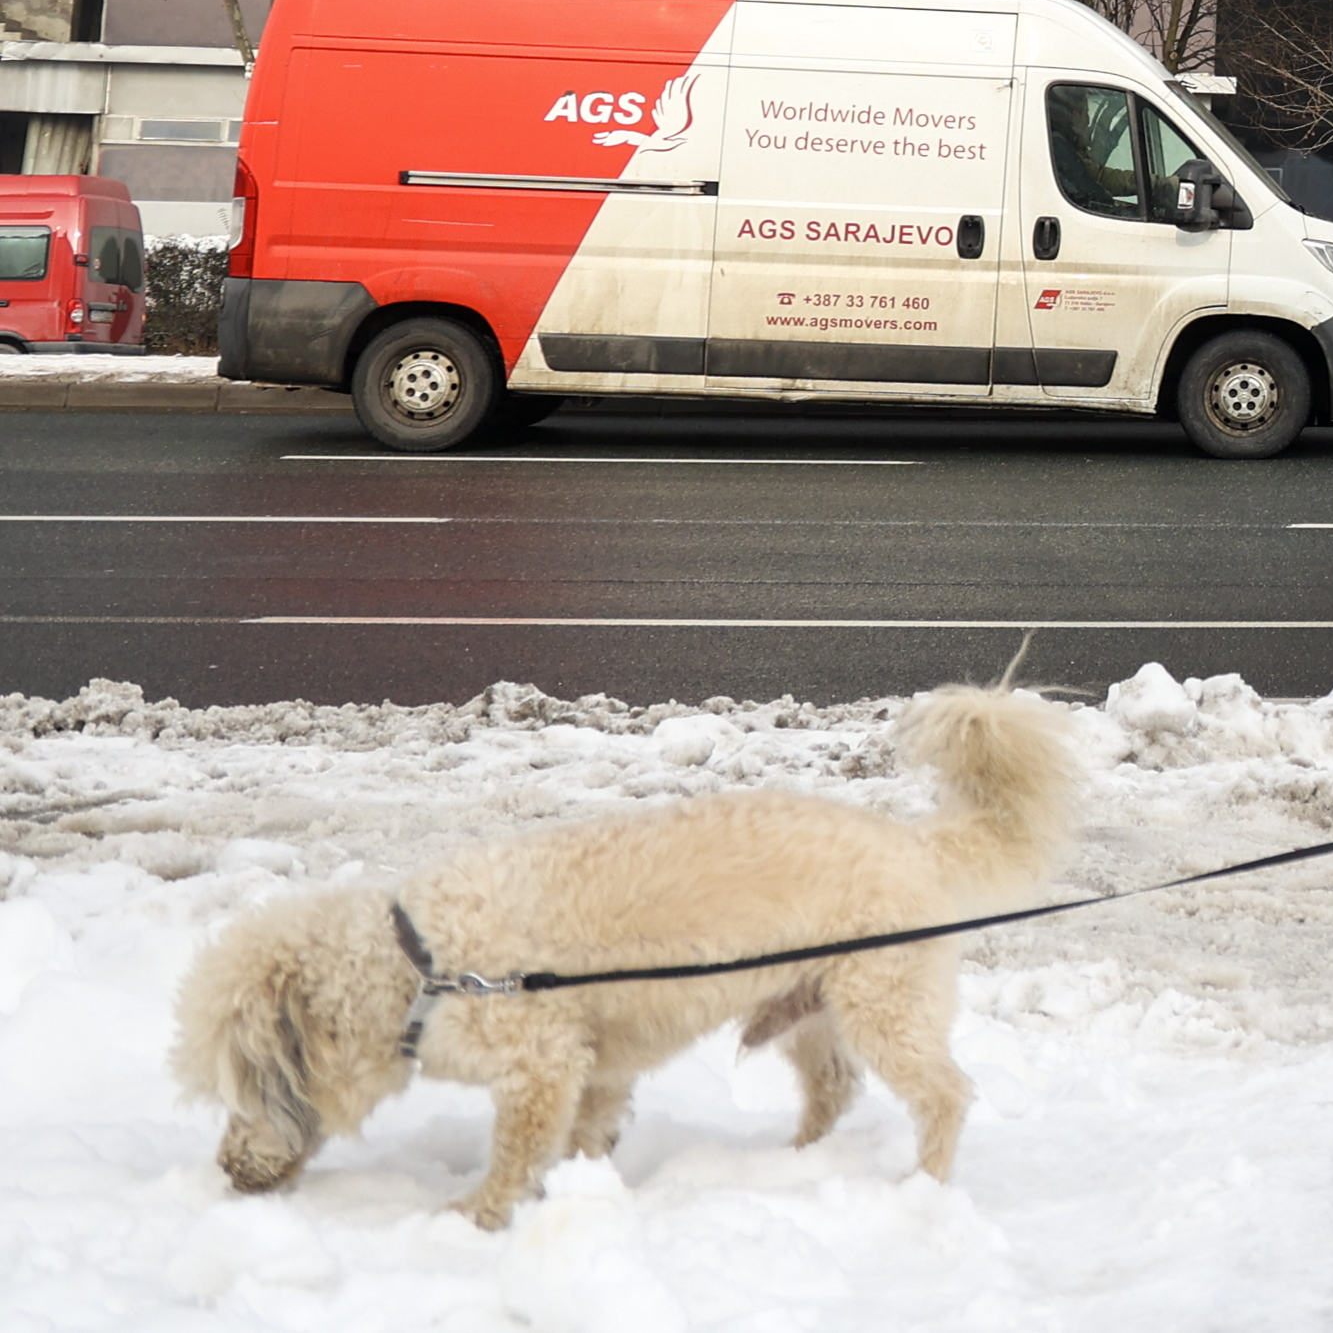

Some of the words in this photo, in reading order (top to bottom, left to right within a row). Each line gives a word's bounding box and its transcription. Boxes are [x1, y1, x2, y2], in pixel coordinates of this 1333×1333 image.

[543, 91, 647, 125] AGS
[761, 99, 886, 125] Worldwide
[893, 107, 977, 131] Movers
[745, 128, 787, 149] You
[794, 131, 886, 155] deserve
[893, 136, 930, 157] the
[938, 138, 987, 160] best
[737, 219, 796, 240] AGS
[805, 221, 954, 246] SARAJEVO
[803, 293, 841, 307] +387
[846, 295, 864, 308] 33
[870, 296, 896, 309] 761
[902, 297, 930, 310] 460
[766, 316, 938, 331] www.agsmovers.com
